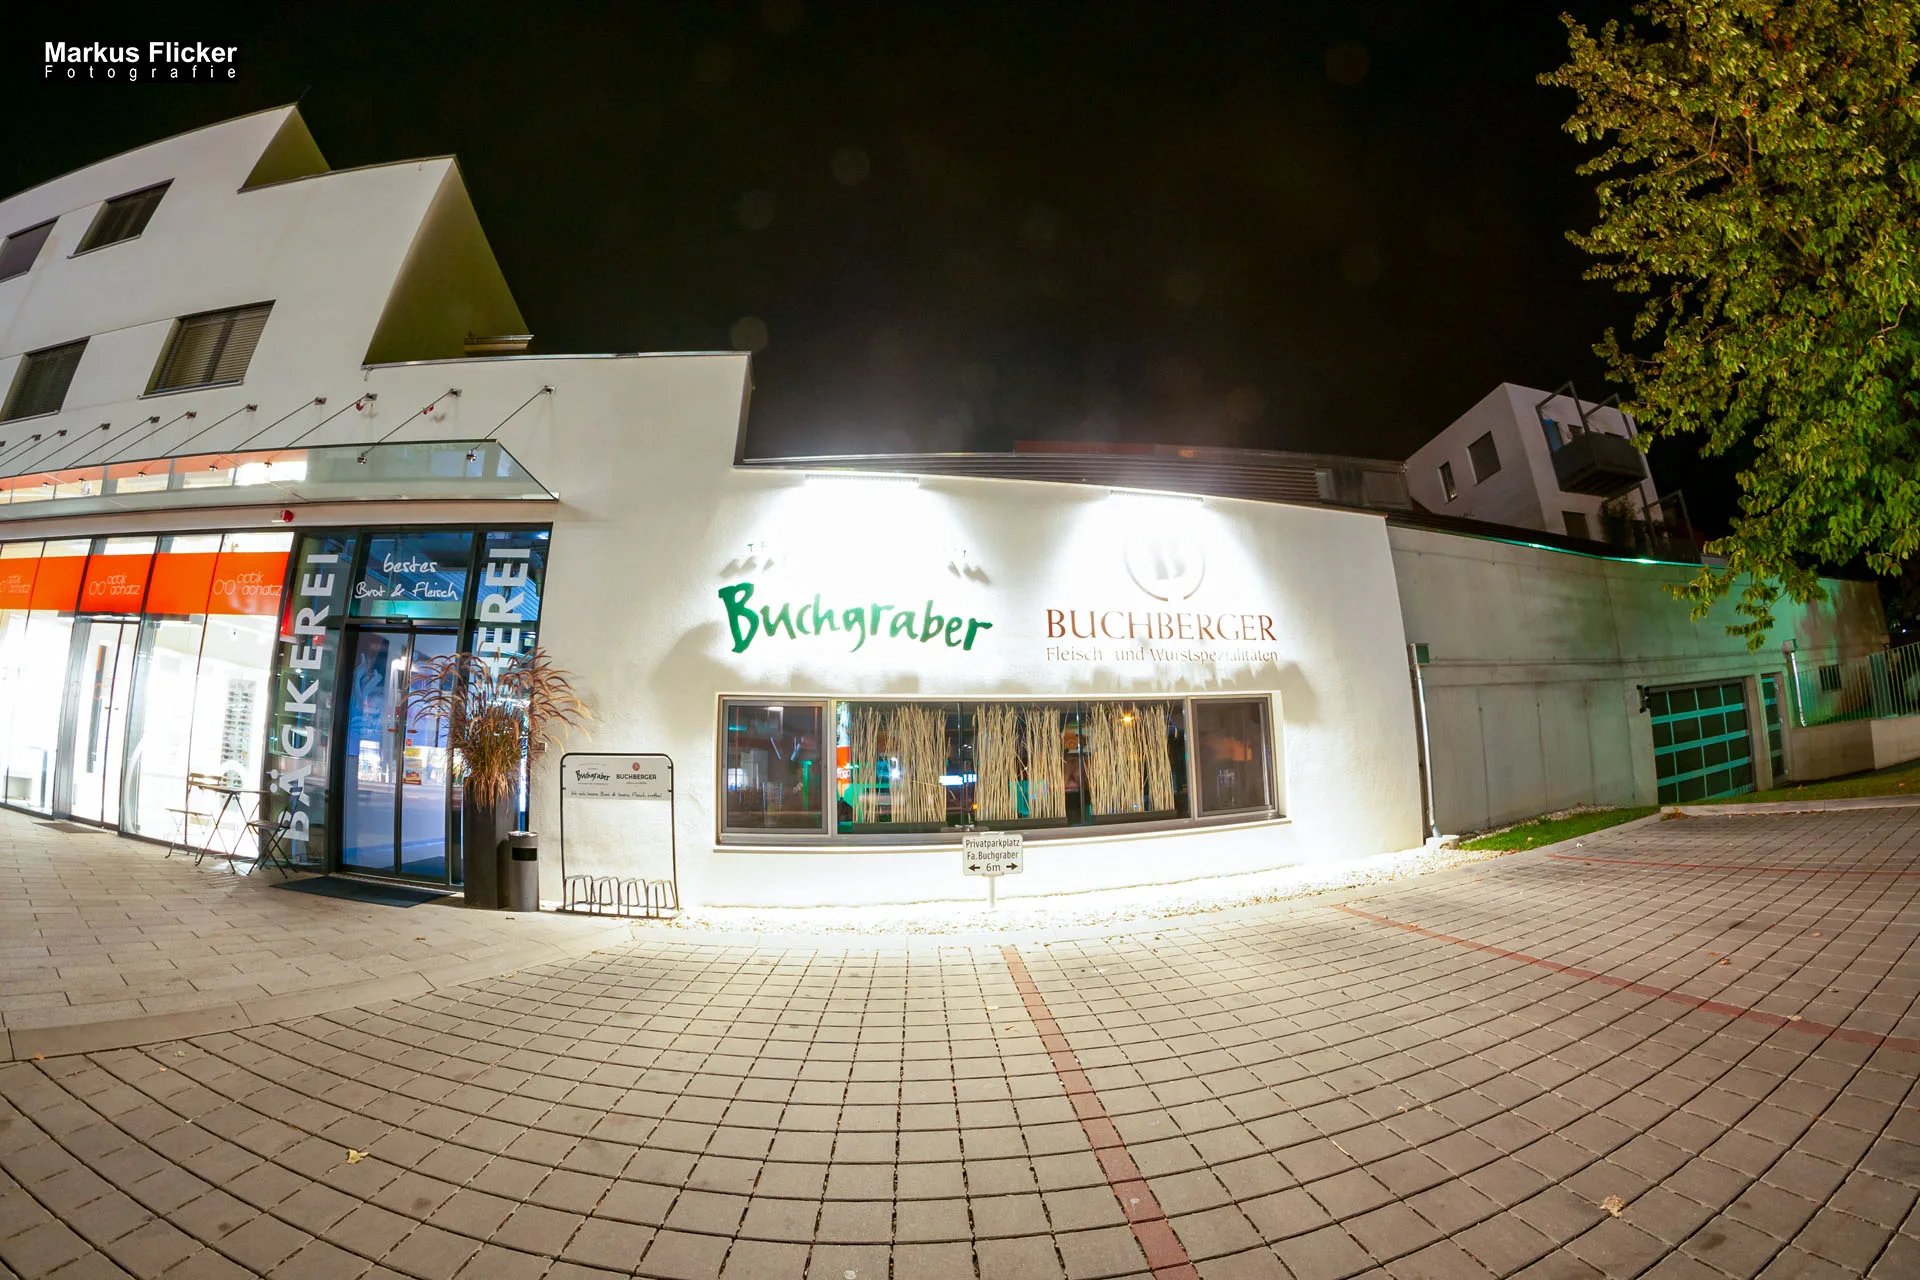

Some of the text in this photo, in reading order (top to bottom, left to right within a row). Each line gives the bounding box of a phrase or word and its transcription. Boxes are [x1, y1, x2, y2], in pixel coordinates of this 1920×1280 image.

[383, 552, 438, 573] bestes
[354, 581, 459, 601] Brot & Fleisch
[718, 582, 993, 654] Buchgraber
[1046, 608, 1278, 641] BUCHBERGER
[1114, 647, 1145, 662] und
[269, 553, 339, 842] BÄCKEREI
[965, 838, 1020, 849] Privatparkplatz
